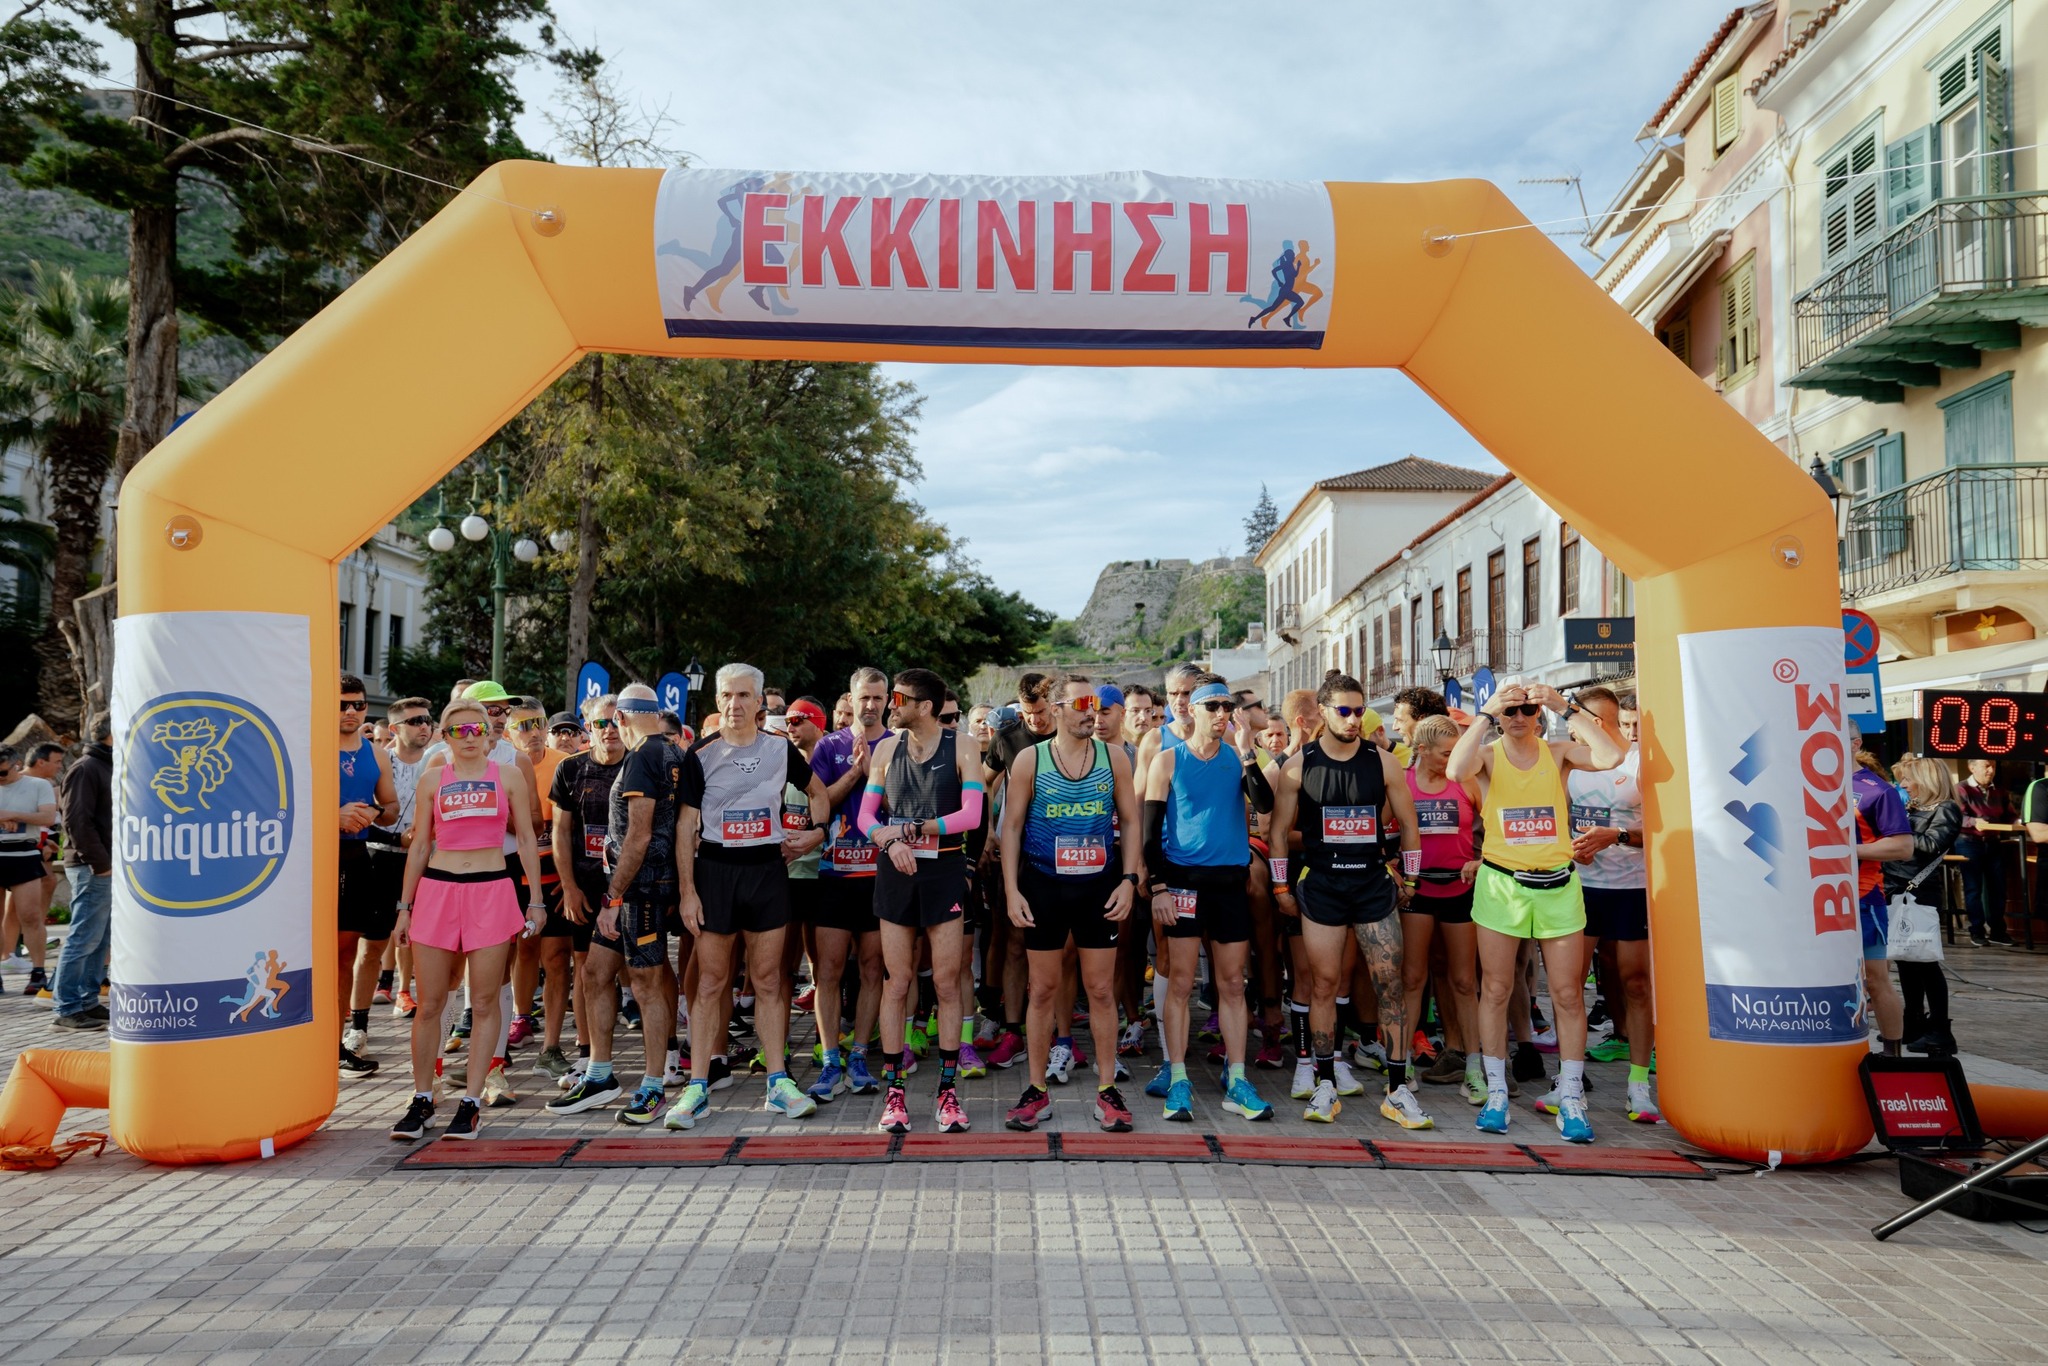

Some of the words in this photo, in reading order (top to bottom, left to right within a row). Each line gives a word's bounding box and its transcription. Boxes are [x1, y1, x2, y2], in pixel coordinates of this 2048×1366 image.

[742, 192, 1250, 295] ΕΚΚΙΝΗΣΗ
[444, 792, 488, 806] 42107
[1046, 800, 1108, 818] BRASIL
[1795, 683, 1856, 936] ΒΙΚΟΣ
[1421, 812, 1449, 821] 21128
[727, 821, 765, 834] 42132
[1328, 819, 1370, 830] 42075
[1508, 819, 1553, 832] 42040
[838, 848, 873, 860] 42017
[1061, 849, 1097, 861] 42113
[116, 990, 199, 1014] Ναύπλιο
[1731, 993, 1831, 1016] Ναύπλιο
[116, 1015, 198, 1030] ΜΑΡΑΘΩΝΙΟΣ
[1735, 1017, 1832, 1031] ΜΑΡΑΘΩΝΙΟΣ
[1897, 1120, 1942, 1129] www.raceresult.com
